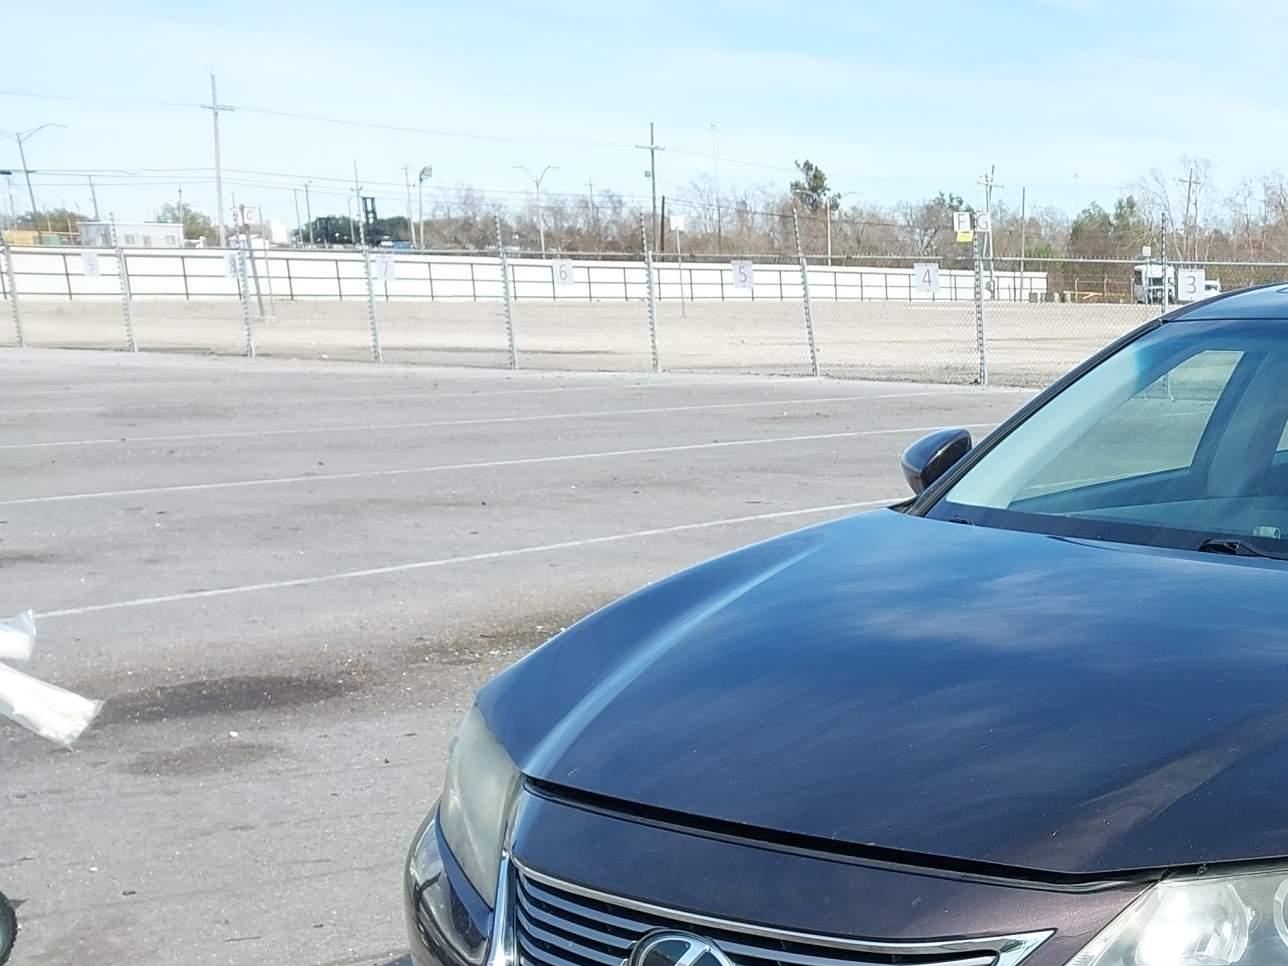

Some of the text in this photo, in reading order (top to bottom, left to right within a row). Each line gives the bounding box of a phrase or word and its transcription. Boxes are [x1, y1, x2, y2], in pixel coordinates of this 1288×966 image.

[977, 213, 989, 231] G
[558, 264, 568, 281] 6
[738, 265, 747, 283] 5
[922, 268, 932, 287] 4
[1186, 275, 1197, 294] 3
